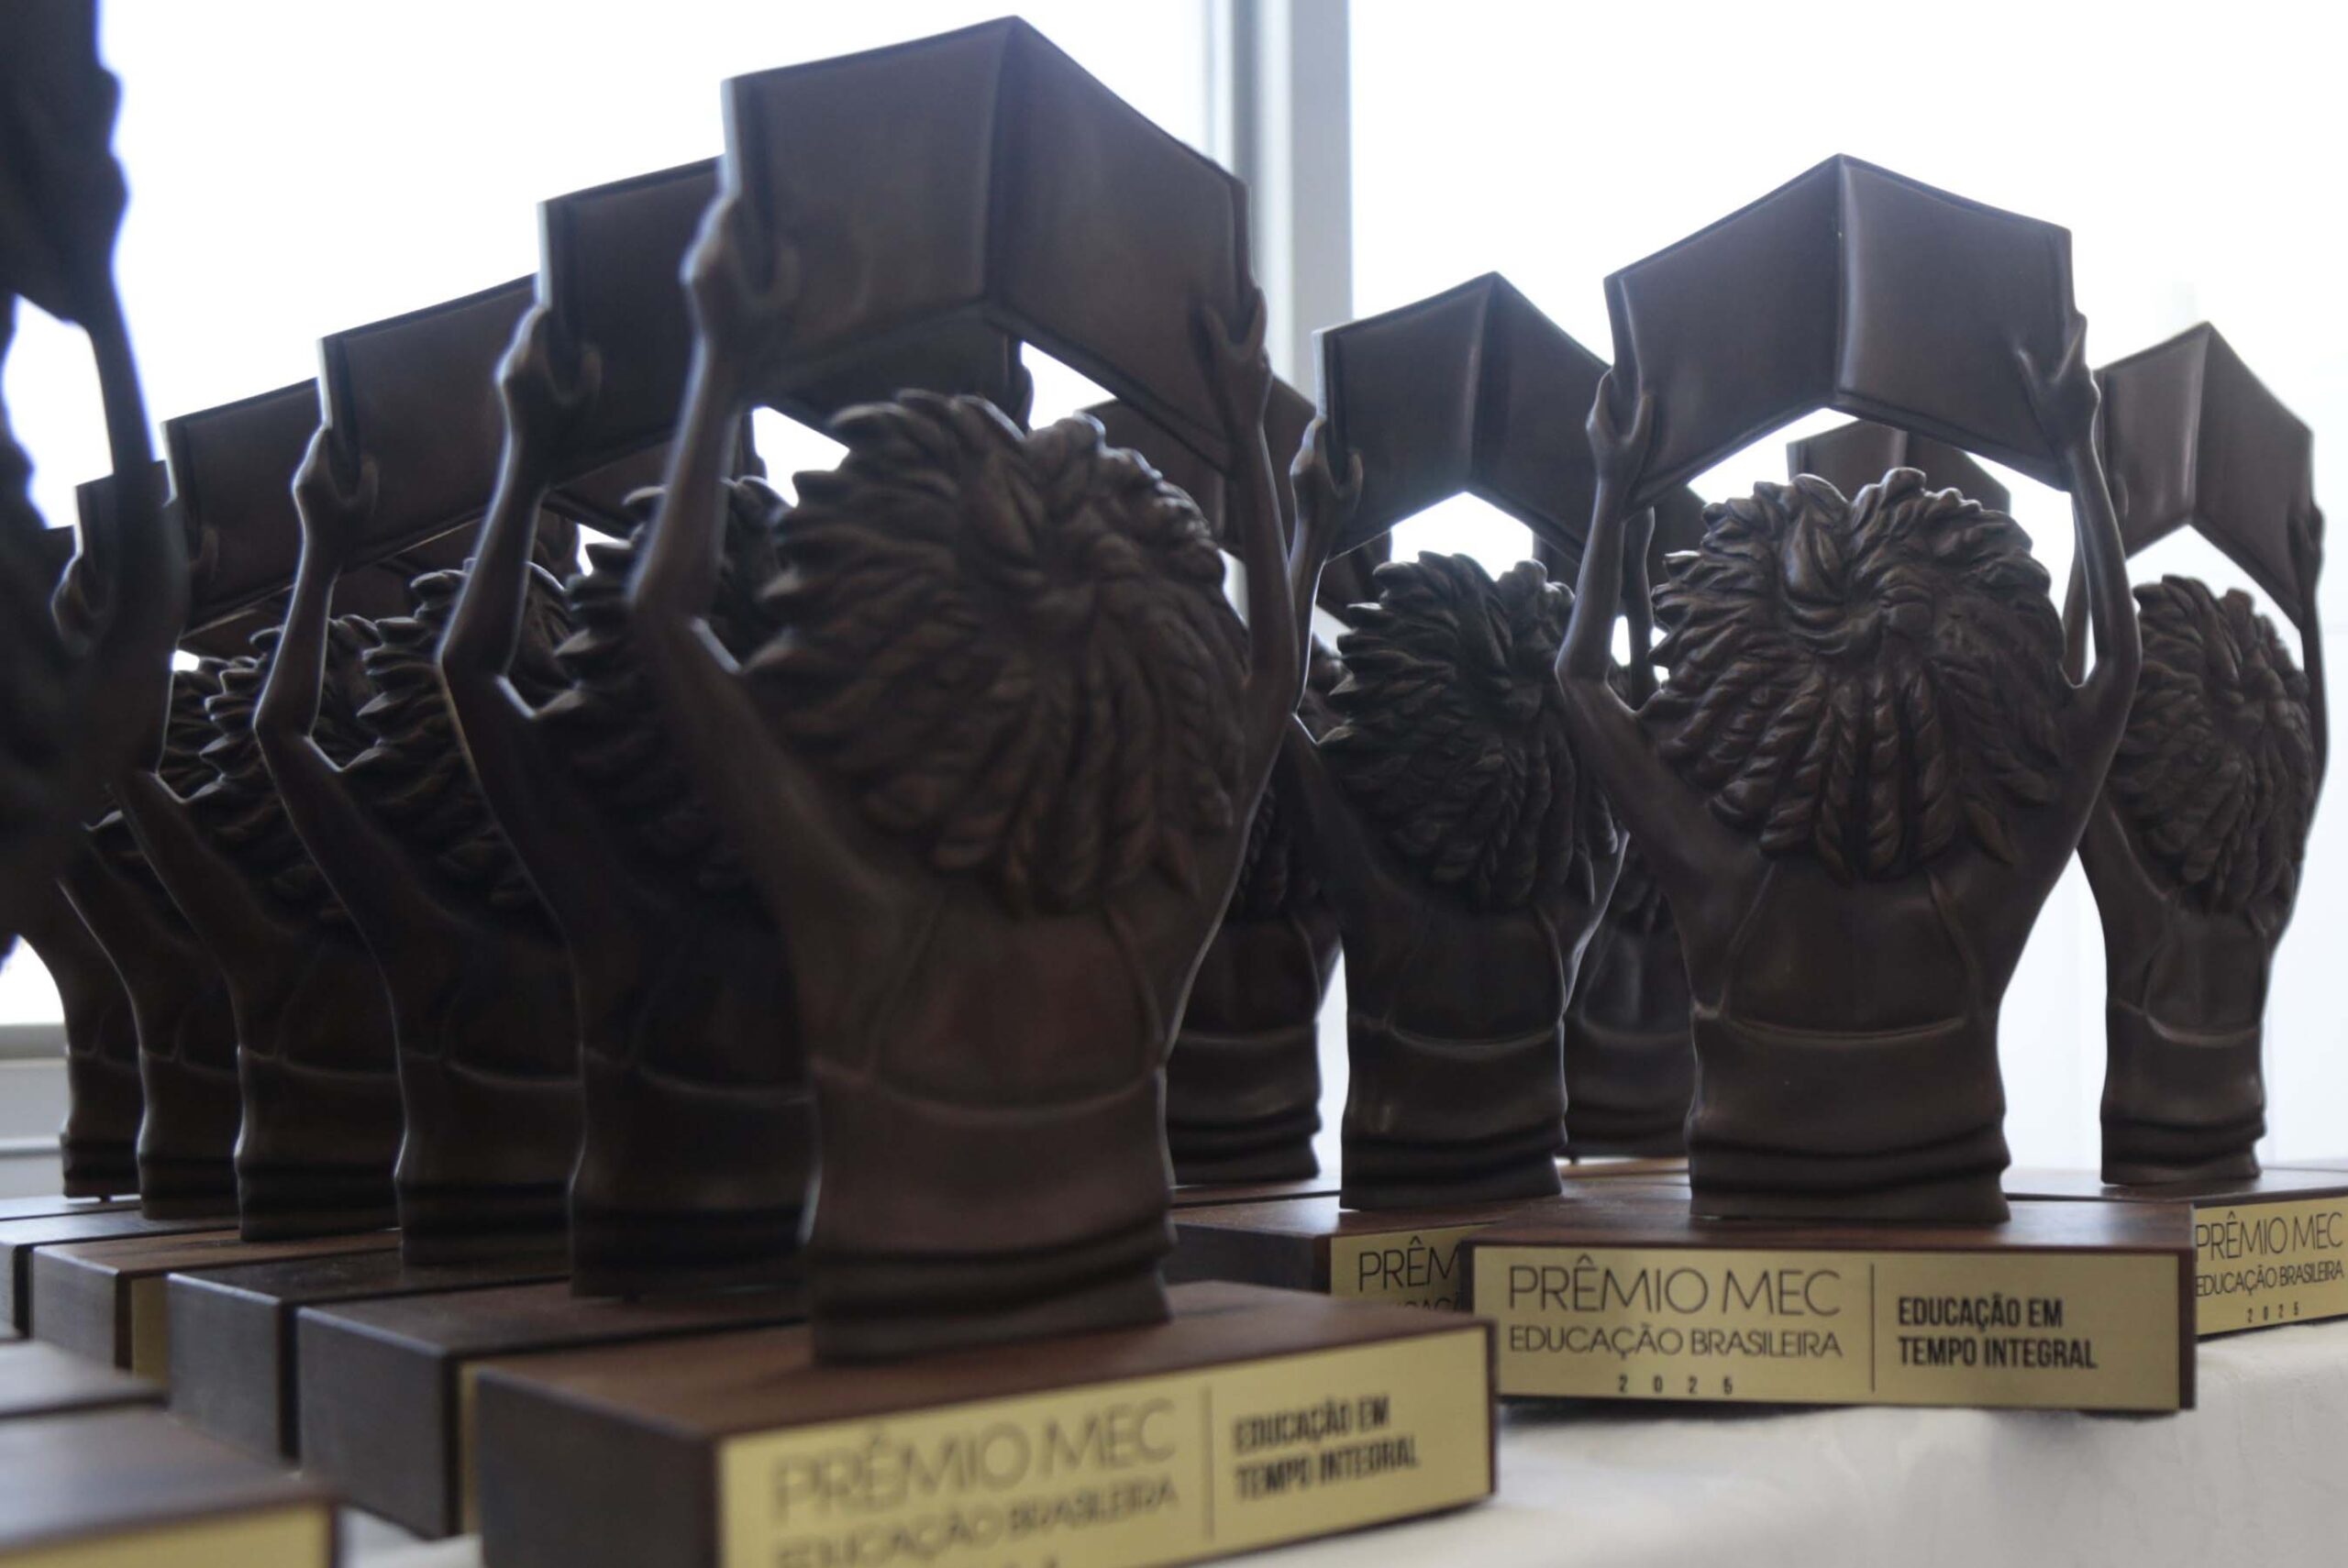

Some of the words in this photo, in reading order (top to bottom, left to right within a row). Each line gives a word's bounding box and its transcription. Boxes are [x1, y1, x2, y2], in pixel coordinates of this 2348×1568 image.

[2195, 1210, 2288, 1261] PRÊMIO
[2293, 1211, 2343, 1252] MEC
[1359, 1235, 1460, 1292] PRÊM
[2195, 1264, 2277, 1297] EDUCAÇÃO
[2279, 1260, 2344, 1286] BRASILEIRA
[1509, 1253, 1709, 1315] PRÊMIO
[1722, 1268, 1841, 1317] MEC
[1898, 1293, 2021, 1333] EDUCAÇÃO
[2029, 1297, 2063, 1329] EM
[1509, 1322, 1684, 1361] EDUCAÇÃO
[1690, 1331, 1844, 1358] BRASILEIRA
[1899, 1336, 1976, 1365] TEMPO
[1984, 1339, 2098, 1369] INTEGRAL
[1357, 1393, 1390, 1432] EM
[1037, 1397, 1178, 1478] MEC
